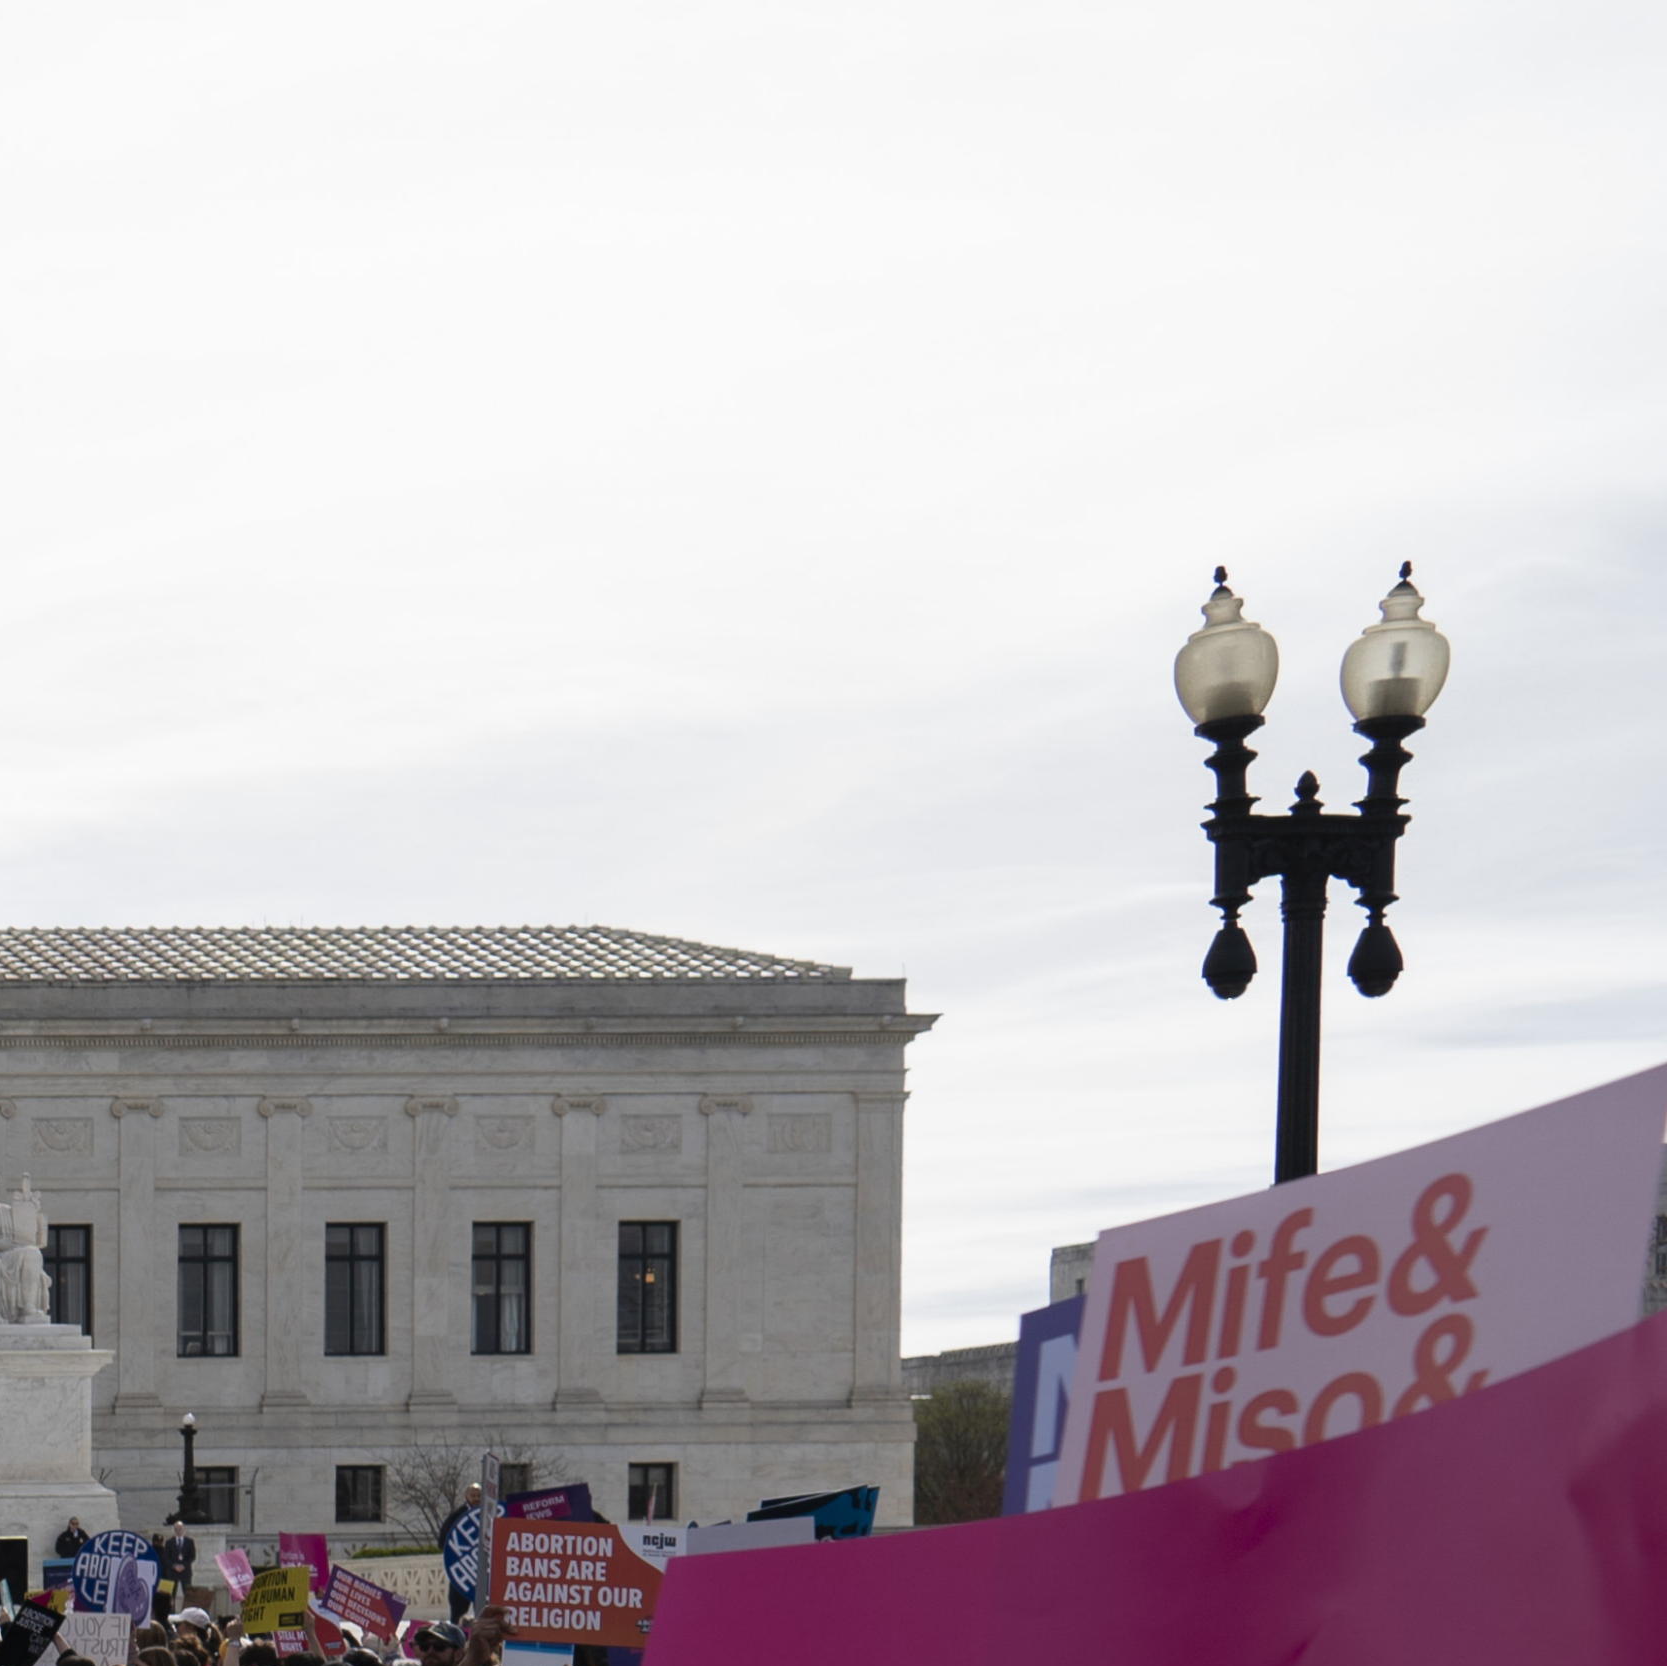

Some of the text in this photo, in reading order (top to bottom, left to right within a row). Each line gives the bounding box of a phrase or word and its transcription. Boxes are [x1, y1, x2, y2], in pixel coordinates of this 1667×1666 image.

[1097, 1172, 1491, 1383] Mife&
[522, 1494, 565, 1511] REFORM
[94, 1532, 147, 1558] KEEP
[506, 1532, 613, 1557] ABORTION
[643, 1533, 677, 1549] ncjw
[506, 1557, 606, 1581] BANS ARE
[504, 1582, 643, 1608] AGAINST OUR
[505, 1607, 601, 1630] RELIGION
